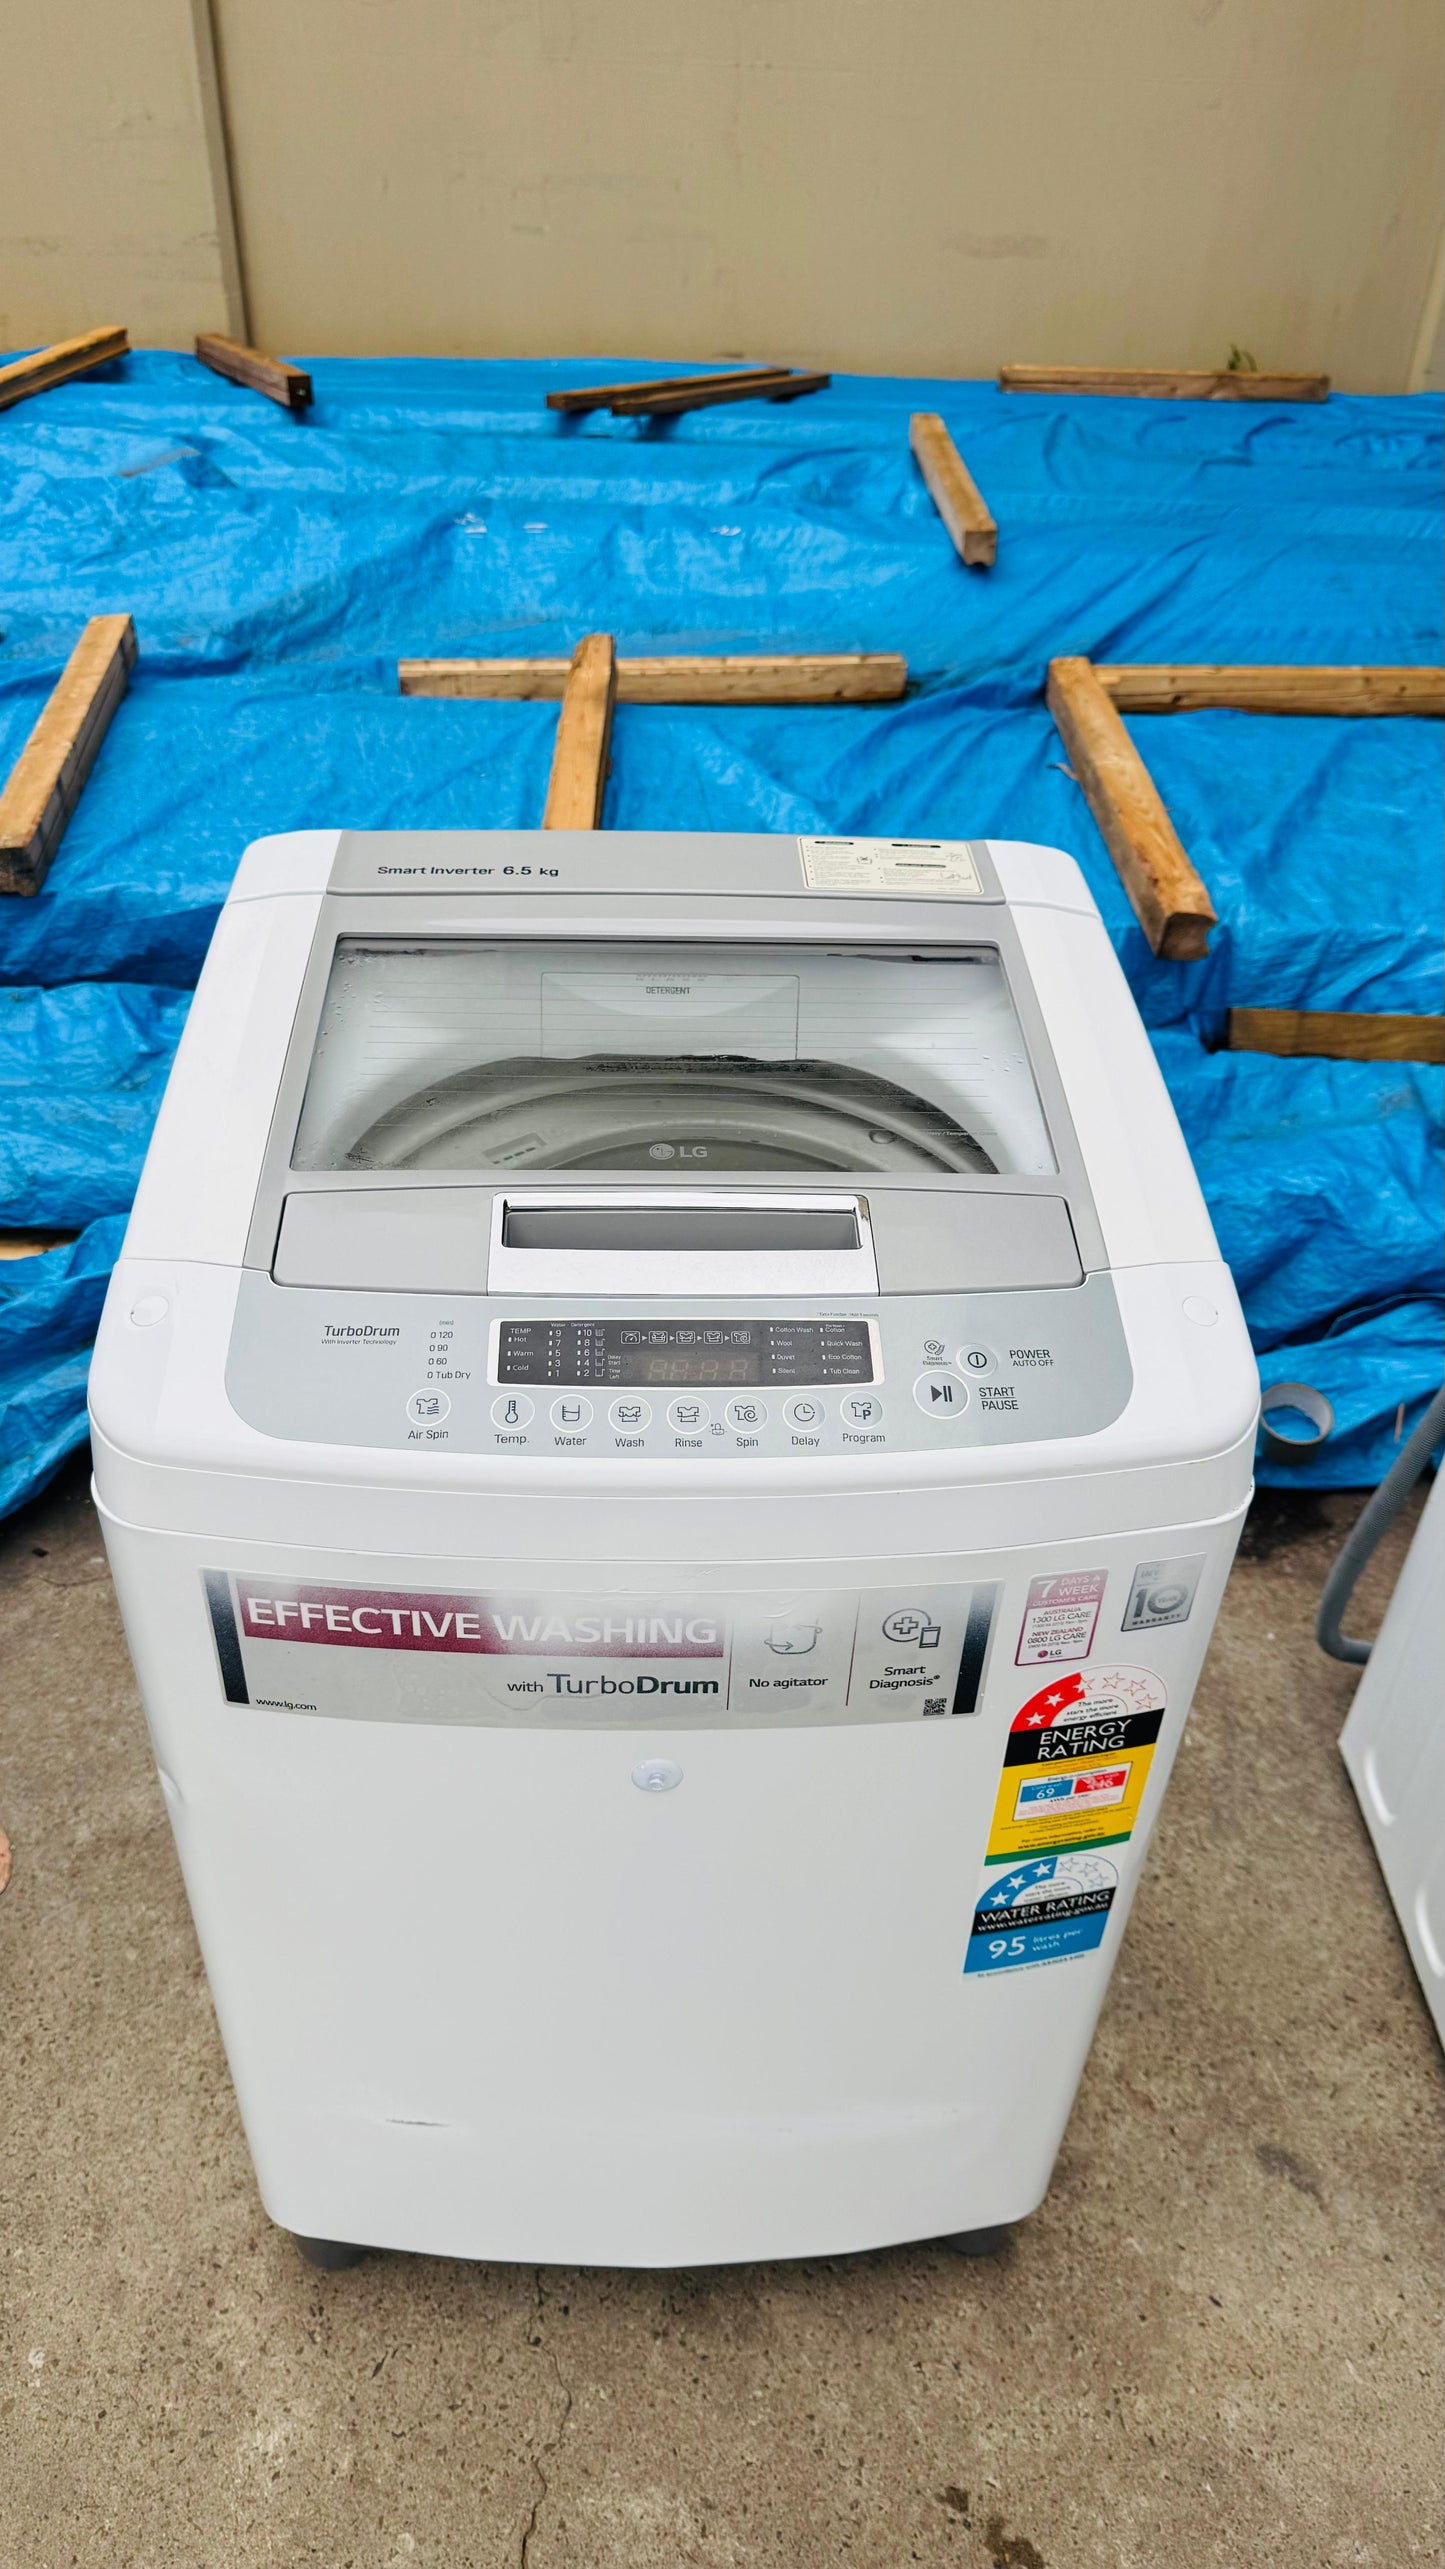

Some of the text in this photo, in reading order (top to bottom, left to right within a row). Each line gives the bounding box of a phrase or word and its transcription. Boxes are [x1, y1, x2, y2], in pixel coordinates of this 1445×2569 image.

[377, 866, 559, 877] Smart Inverter 6.5 kg
[646, 986, 690, 994] DETERGENT
[680, 1146, 707, 1157] LG
[324, 1325, 400, 1337] TurboDrum
[1010, 1350, 1050, 1358] POWER
[436, 1371, 471, 1380] Tub Dry
[979, 1387, 1015, 1397] START
[981, 1400, 1019, 1410] PAUSE
[408, 1430, 448, 1440] Air Spin
[494, 1434, 530, 1445] Temp.
[842, 1433, 886, 1444] Program
[554, 1437, 587, 1446] Water
[615, 1438, 644, 1447] Wash
[675, 1438, 702, 1447] Rinse
[736, 1438, 758, 1448] Spin
[792, 1436, 820, 1447] Delay
[1038, 1579, 1058, 1598] 7
[1060, 1576, 1089, 1586] DAYS
[1059, 1584, 1099, 1596] WEEK
[1032, 1597, 1076, 1606] CUSTOMER
[1043, 1607, 1082, 1615] AUSTRALIA
[1067, 1611, 1092, 1619] CARE
[247, 1597, 718, 1645] EFFECTIVE WASHING
[1050, 1626, 1084, 1635] ZEALAND
[1027, 1636, 1048, 1644] 0800
[1062, 1632, 1087, 1640] CARE
[884, 1666, 926, 1676] Smart
[507, 1673, 719, 1695] with TurboDrum
[749, 1676, 828, 1689] No agitator
[255, 1699, 317, 1711] www.lg.com
[1040, 1719, 1132, 1745] ENERGY
[1037, 1736, 1126, 1760] RATING
[1036, 1788, 1055, 1799] 69
[981, 1905, 1041, 1923] WATER
[1046, 1891, 1110, 1912] RATING
[977, 1903, 1108, 1932] www.waterrating.gov.au
[988, 1936, 1027, 1959] 95
[1032, 1942, 1060, 1952] wash
